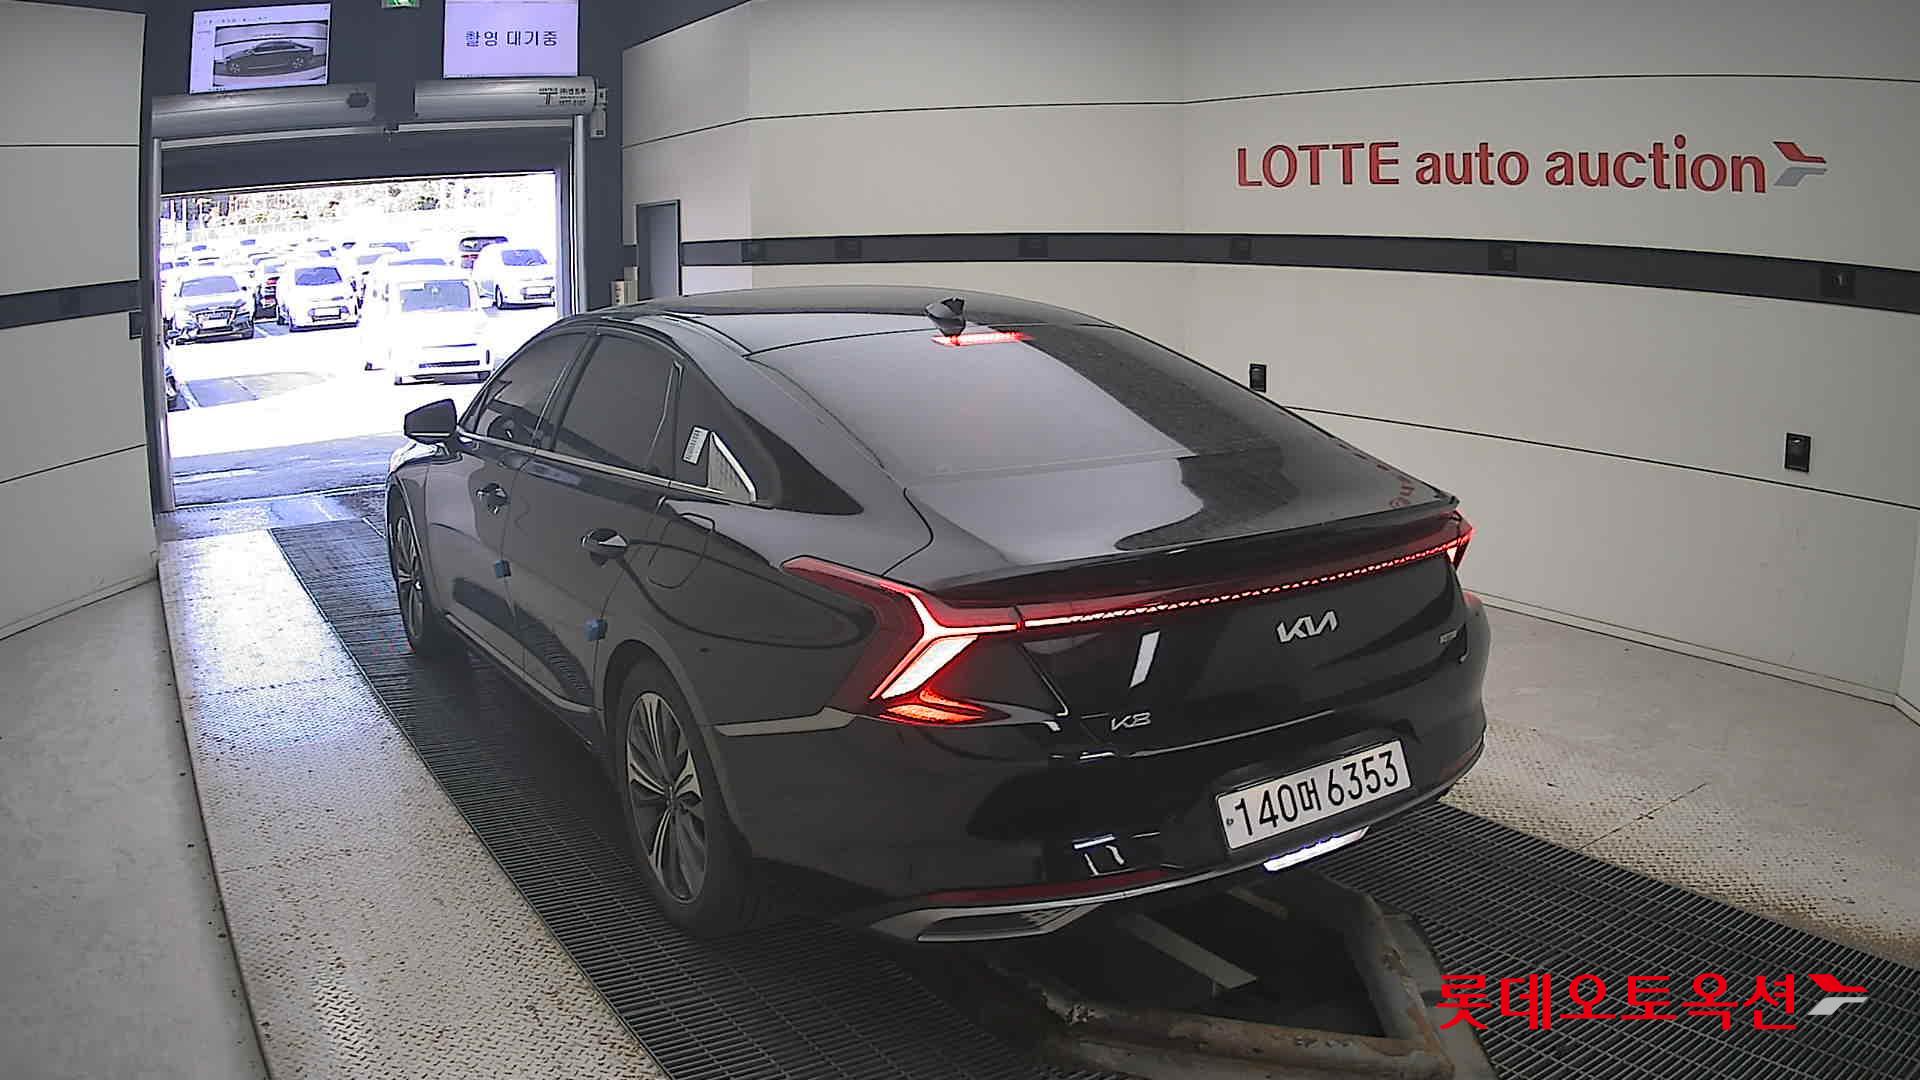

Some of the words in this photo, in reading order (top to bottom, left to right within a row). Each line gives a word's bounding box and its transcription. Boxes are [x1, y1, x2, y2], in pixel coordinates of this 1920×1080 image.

[1237, 141, 1400, 188] LOTTE
[1415, 142, 1529, 186] auto
[1545, 134, 1767, 194] auction
[1111, 712, 1151, 731] K8
[1234, 777, 1322, 836] 140머
[1327, 750, 1399, 806] 6353
